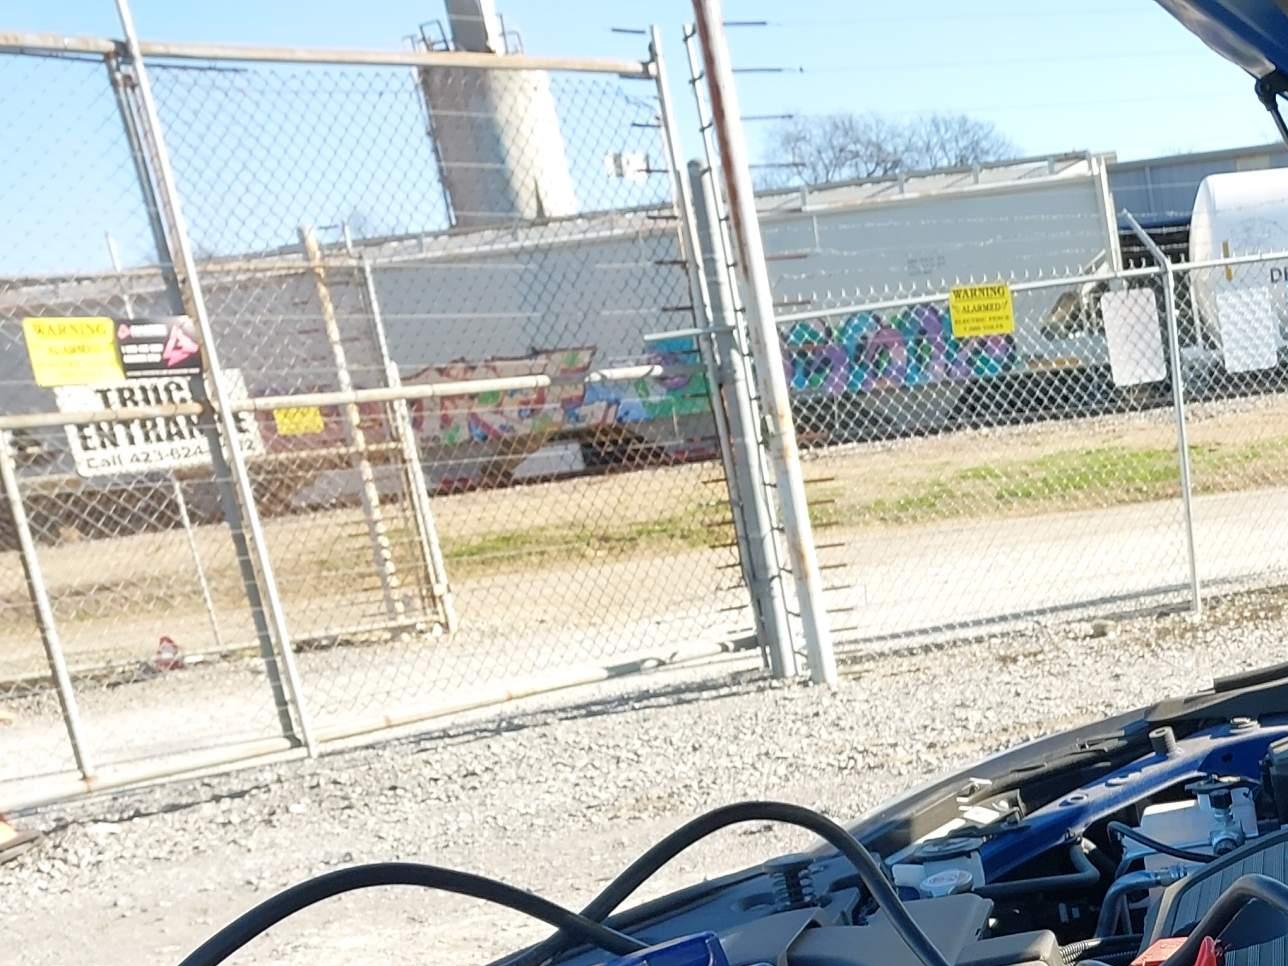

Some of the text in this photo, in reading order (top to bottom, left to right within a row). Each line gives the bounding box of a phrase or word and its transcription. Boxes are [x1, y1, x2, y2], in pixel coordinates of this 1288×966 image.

[952, 285, 1005, 299] WARNING
[32, 322, 106, 336] WARNING
[86, 453, 122, 470] Call
